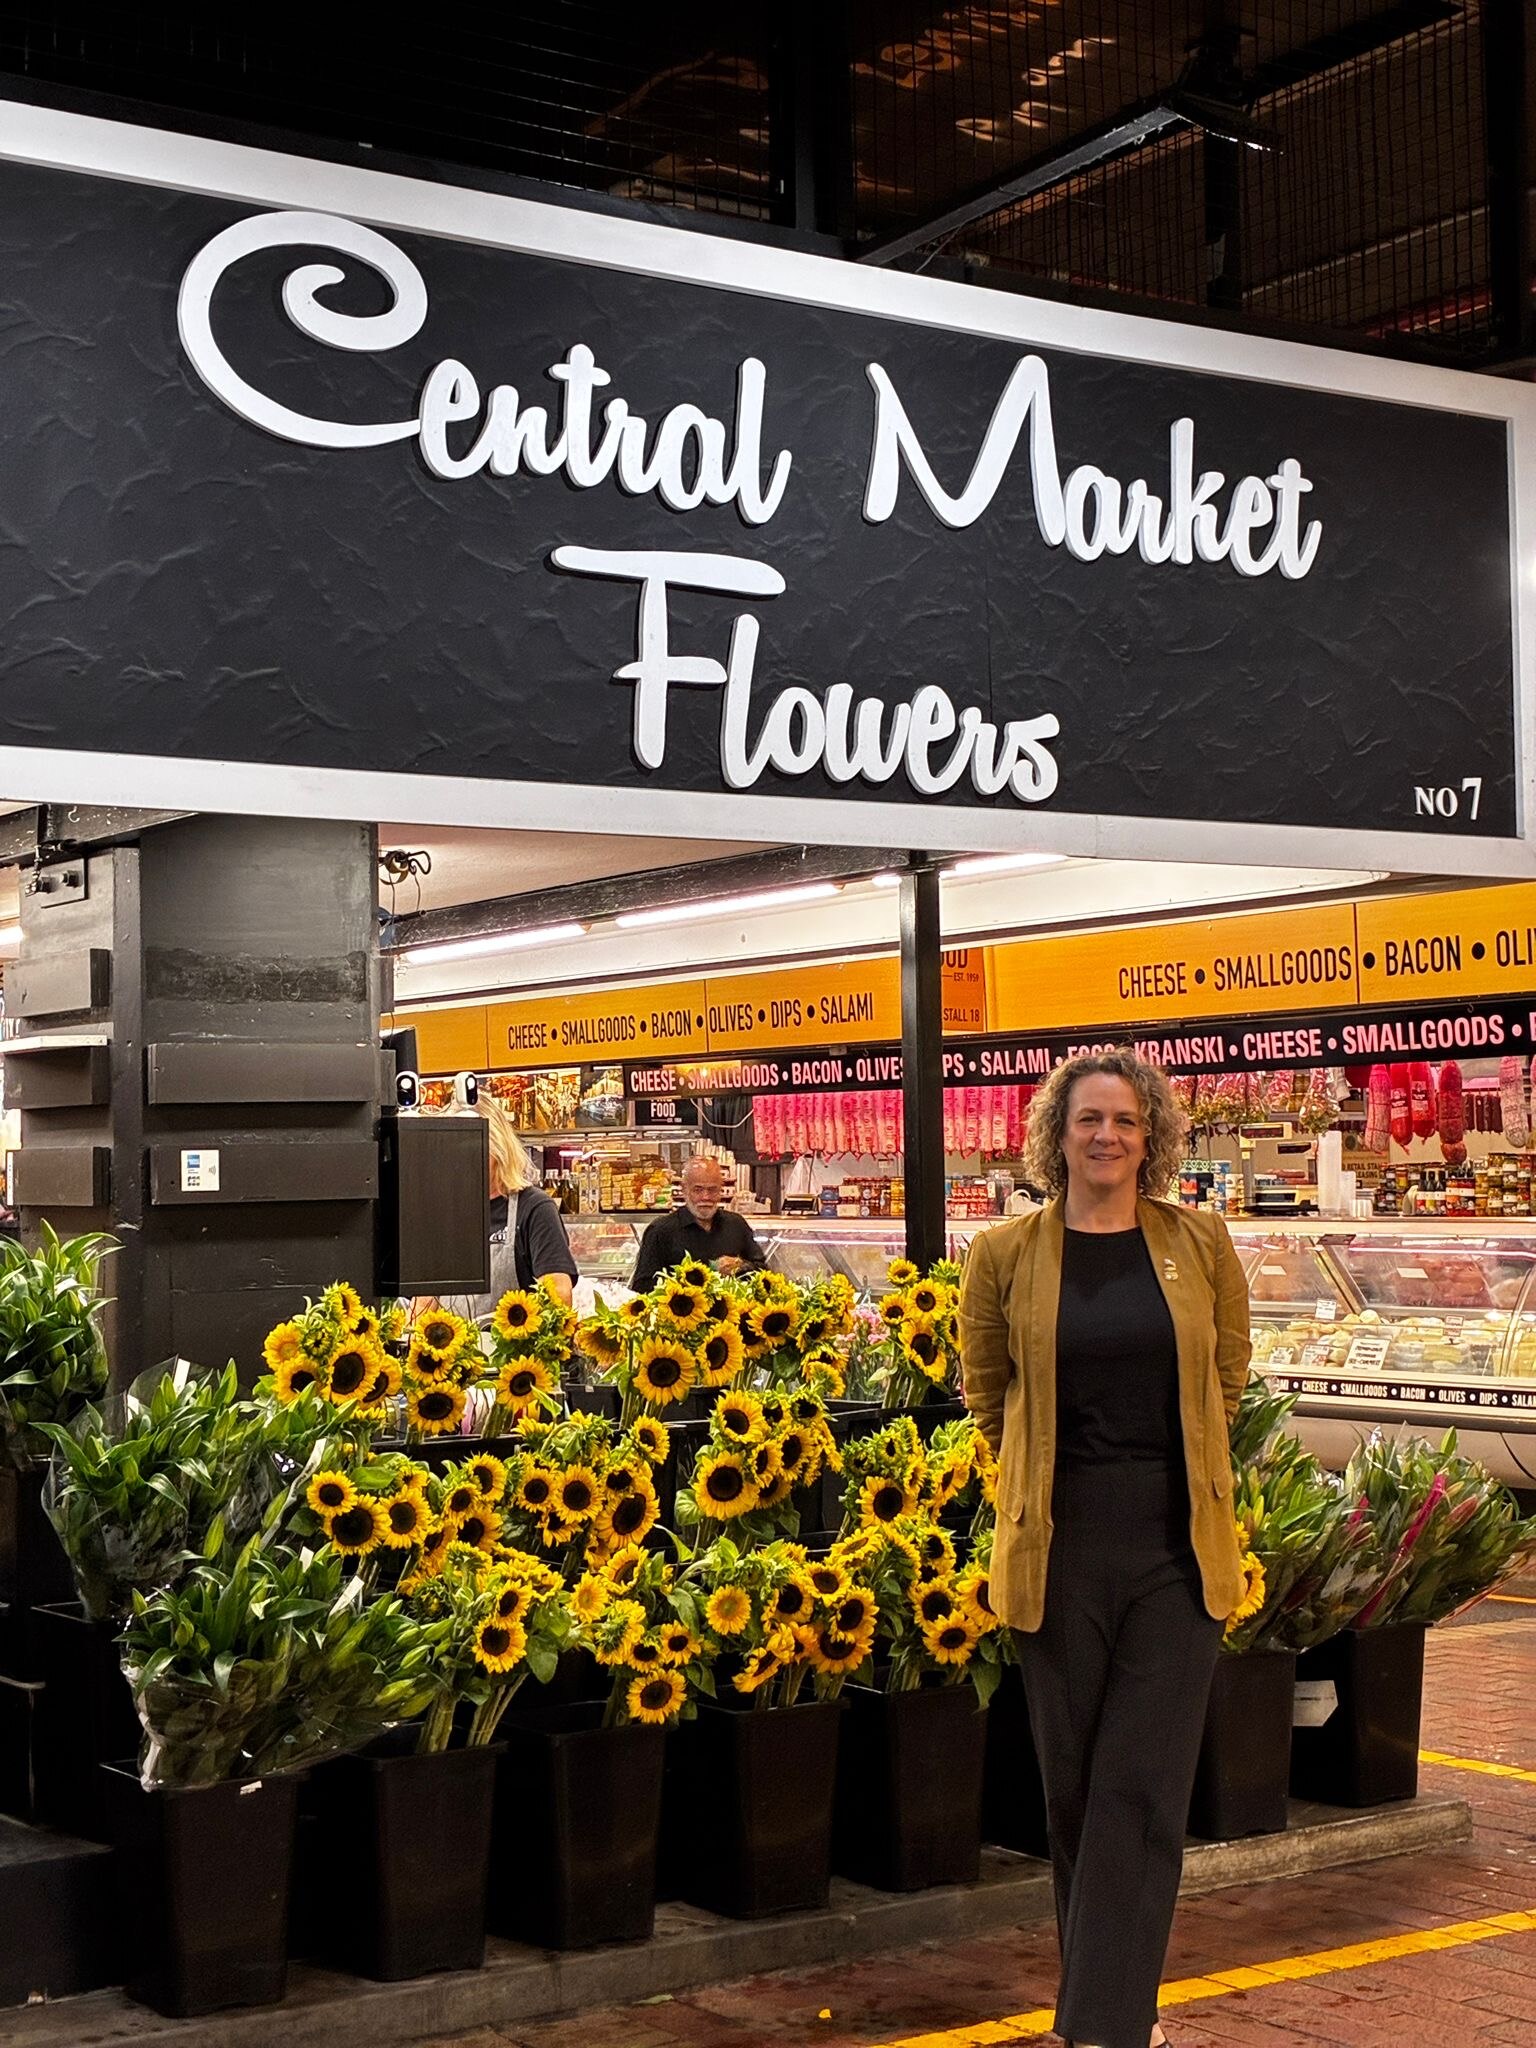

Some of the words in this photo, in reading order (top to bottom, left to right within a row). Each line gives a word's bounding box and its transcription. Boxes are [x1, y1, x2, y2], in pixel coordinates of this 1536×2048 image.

[176, 210, 792, 526] Central
[861, 353, 1323, 580] Market
[550, 544, 1061, 803] Flowers
[1413, 786, 1459, 818] NO
[1461, 777, 1482, 821] 7
[1119, 961, 1188, 999] CHEESE
[1213, 945, 1352, 991] SMALLGOODS
[1385, 935, 1462, 976] BACON
[1495, 927, 1536, 968] OLI
[508, 1022, 548, 1050] CHEESE
[561, 1014, 636, 1046] SMALLGOODS
[651, 1008, 692, 1039] BACON
[708, 1003, 753, 1034] OLIVES
[770, 998, 802, 1029] DIPS
[820, 992, 874, 1025] SALAMI
[943, 1007, 968, 1022] STALL
[970, 1008, 980, 1022] 18
[630, 1068, 677, 1093] CHEESE
[687, 1062, 780, 1090] SMALLGOODS
[791, 1059, 843, 1086] BACON
[980, 1047, 1051, 1077] SALAMI
[1134, 1035, 1225, 1067] KRANSKI
[1242, 1028, 1323, 1061] CHEESE
[1342, 1014, 1505, 1055] SMALLGOODS
[650, 1102, 676, 1118] FOOD
[1302, 1380, 1329, 1393] CHEESE
[1340, 1383, 1388, 1398] SMALLGOODS
[1400, 1387, 1426, 1400] BACON
[1438, 1389, 1466, 1403] OLIVES
[1479, 1392, 1498, 1405] DIPS
